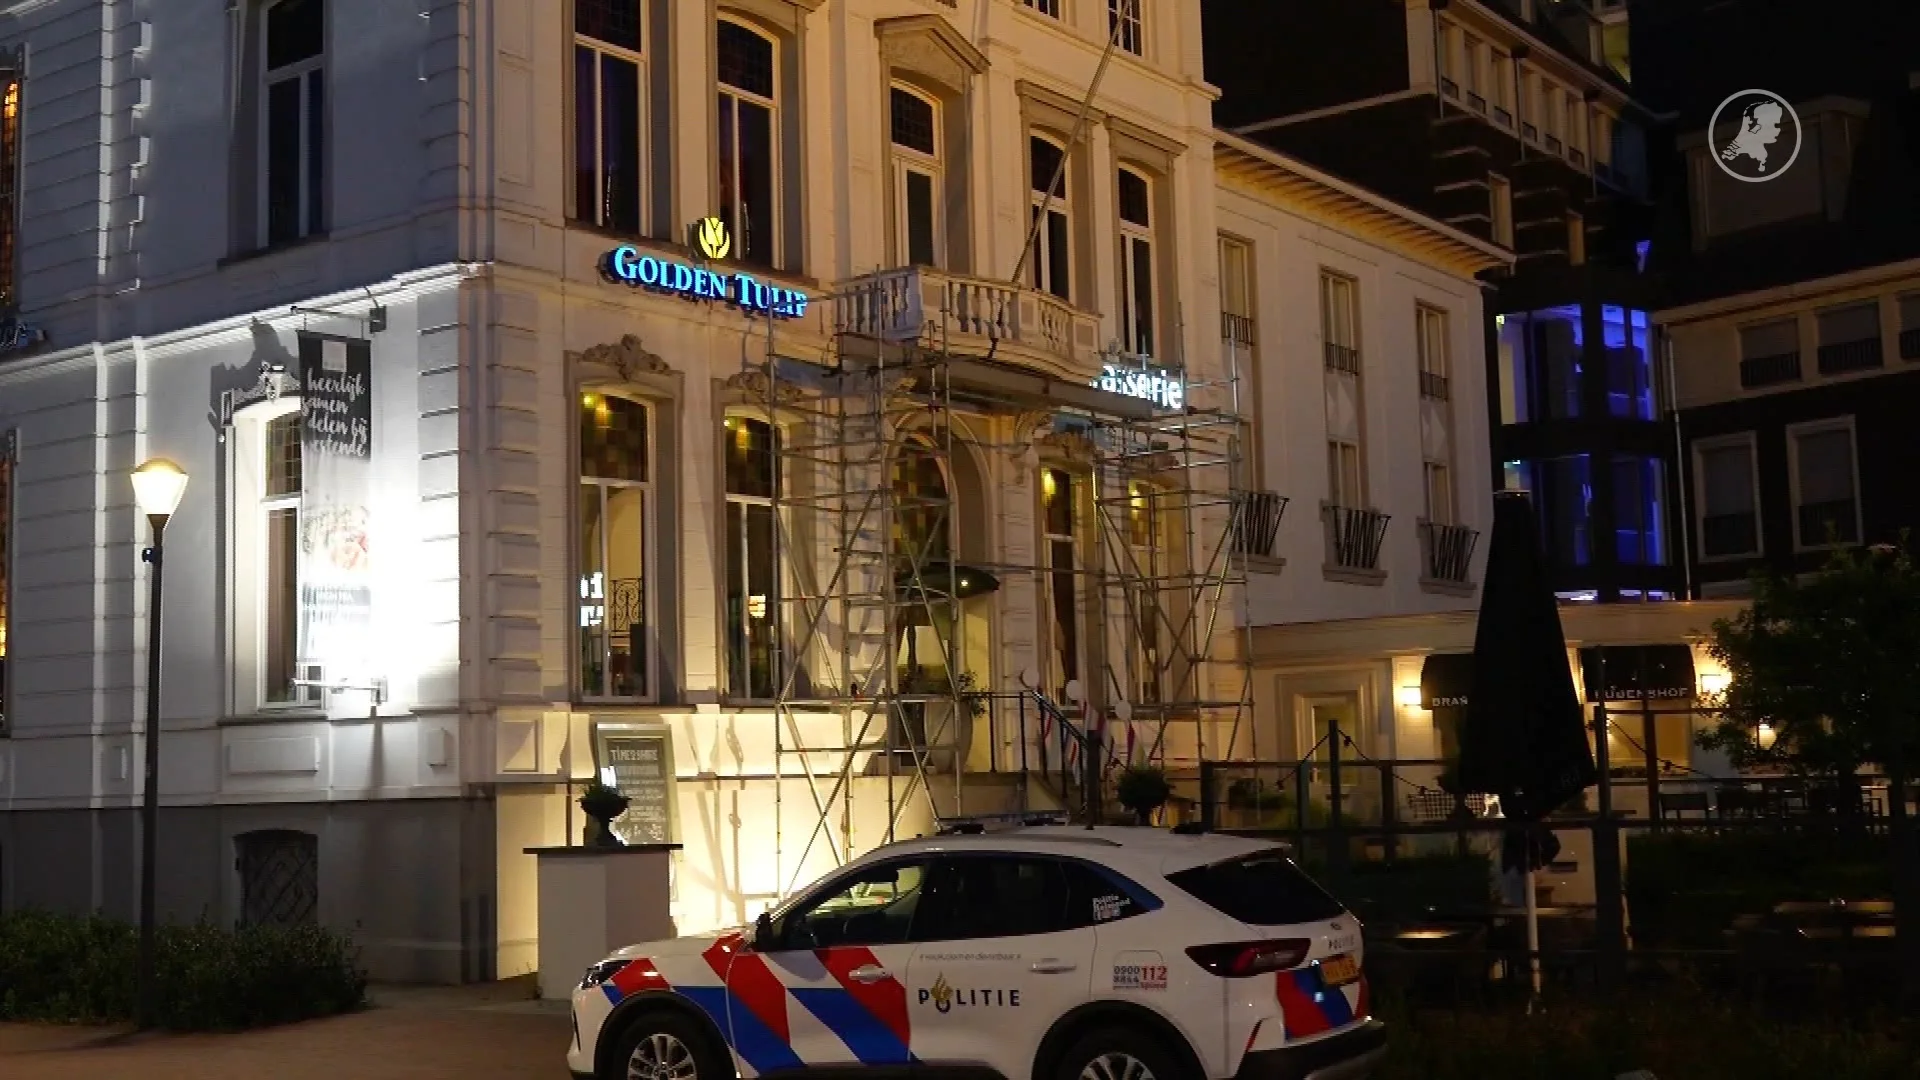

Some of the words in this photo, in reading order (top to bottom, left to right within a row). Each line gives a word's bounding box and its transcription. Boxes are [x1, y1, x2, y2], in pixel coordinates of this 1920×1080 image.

[611, 245, 727, 298] GOLDEN
[307, 367, 366, 402] heerlijk
[308, 411, 348, 435] delen
[1141, 965, 1168, 981] 112
[918, 986, 1020, 1014] POLITIE
